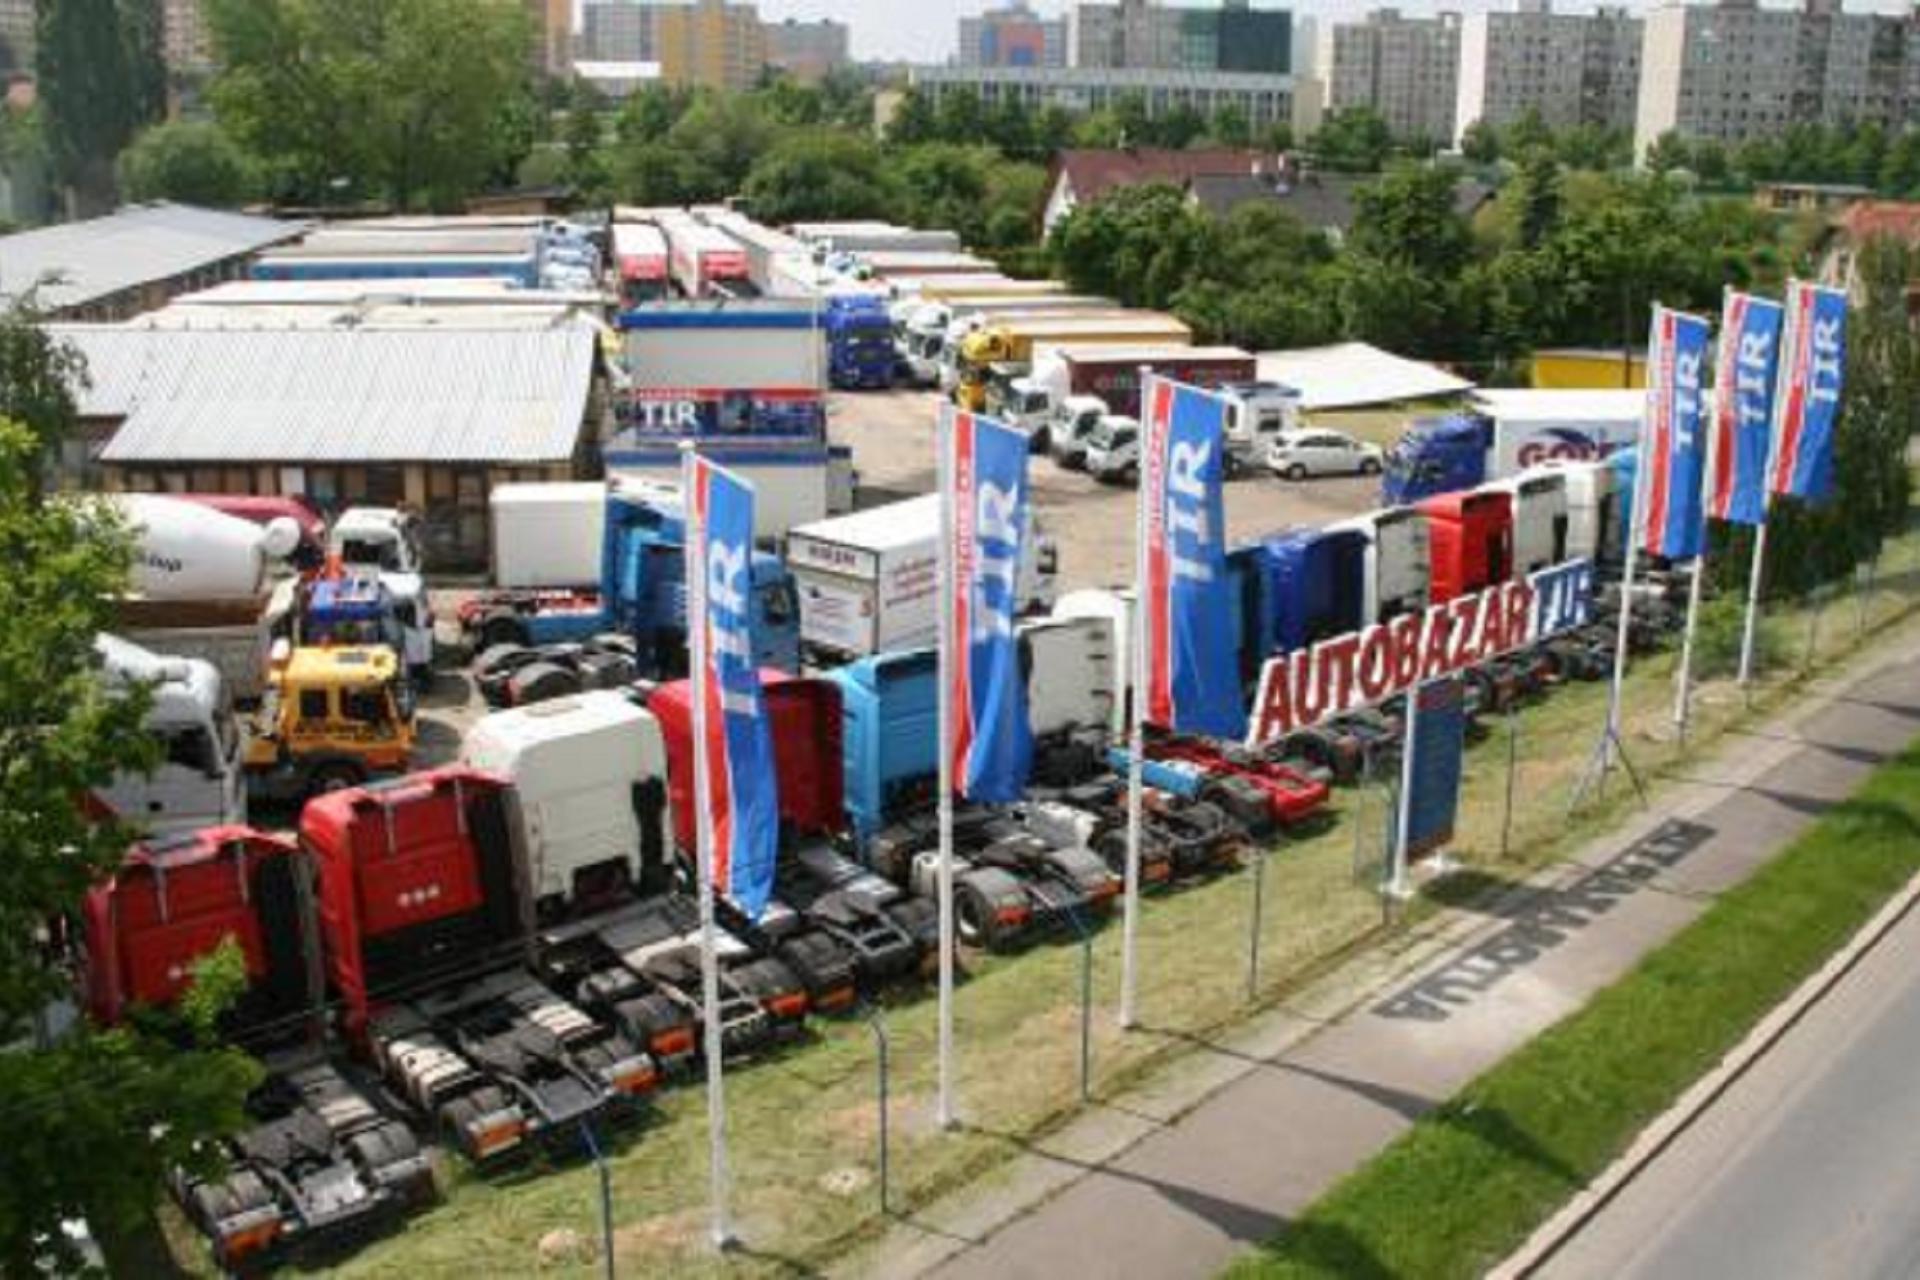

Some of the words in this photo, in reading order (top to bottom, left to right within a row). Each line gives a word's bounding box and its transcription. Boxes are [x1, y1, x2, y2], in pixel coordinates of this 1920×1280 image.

[1672, 352, 1700, 453] TIR
[1736, 330, 1771, 426] TIR
[1806, 317, 1840, 405] TIR
[640, 401, 697, 428] TIR
[973, 480, 1018, 641] TIR
[1168, 439, 1214, 586] TIR
[1248, 581, 1536, 749] AUTOBAZAR
[1531, 557, 1596, 642] TIR
